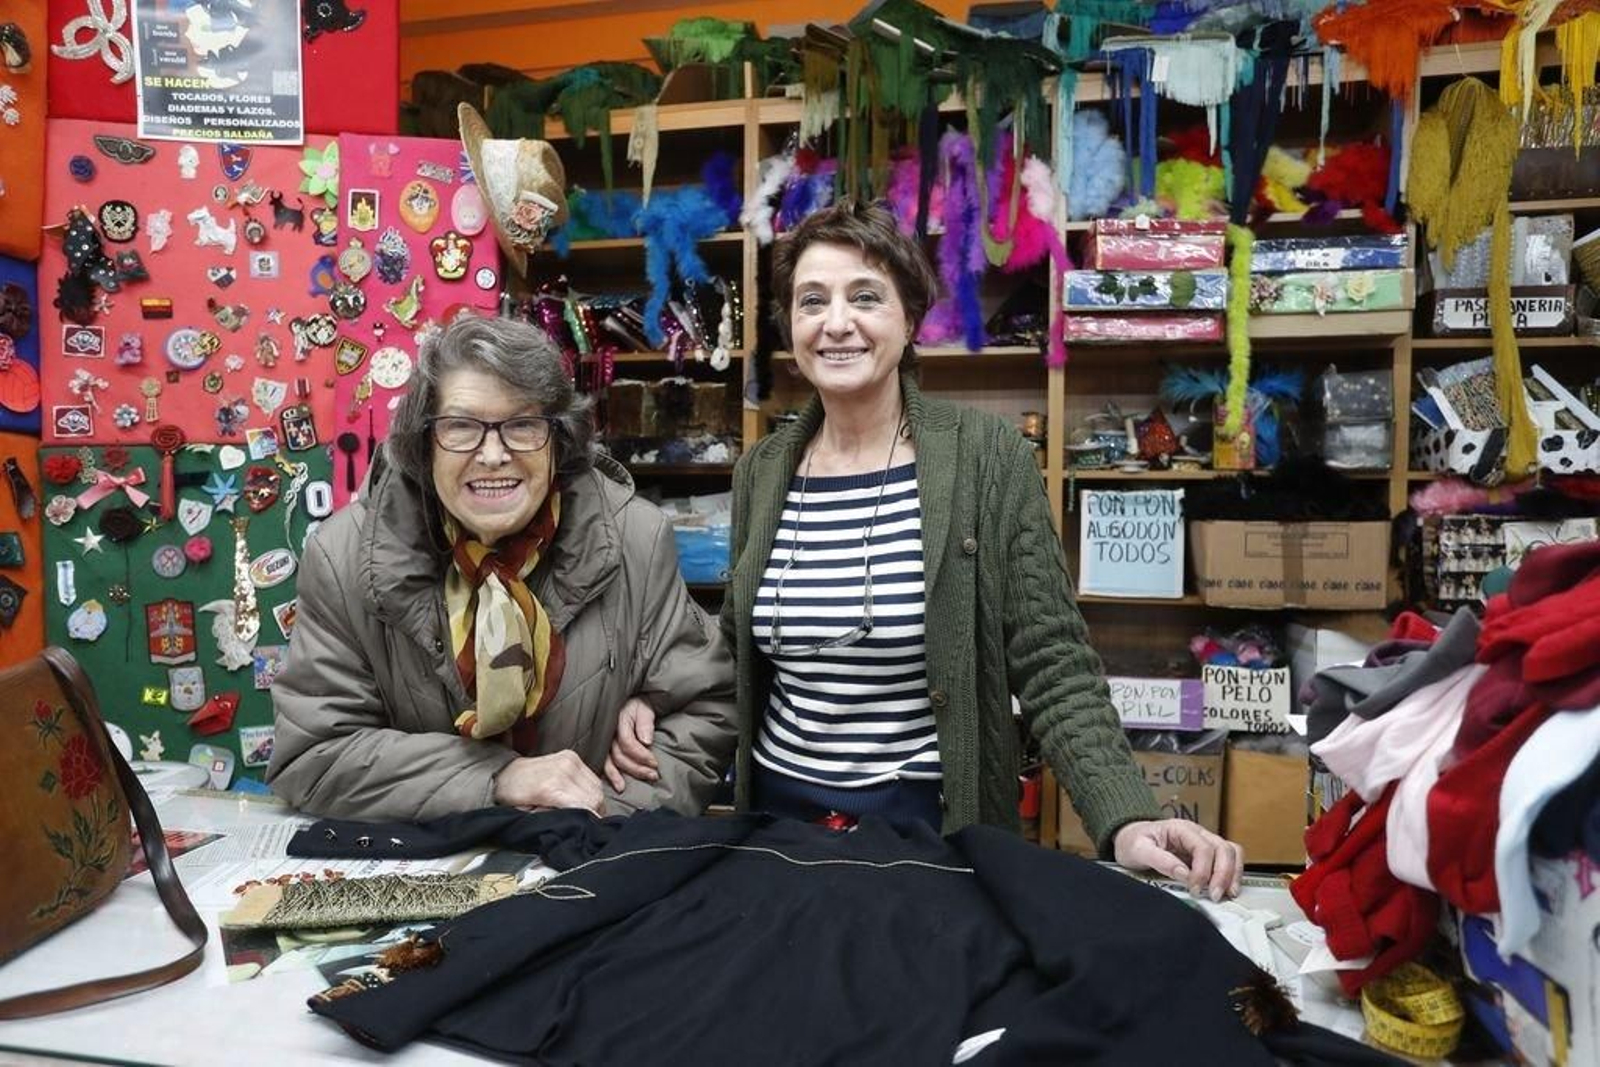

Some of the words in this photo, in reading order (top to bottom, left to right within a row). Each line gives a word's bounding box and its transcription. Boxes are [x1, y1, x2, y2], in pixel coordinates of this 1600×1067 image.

[144, 76, 162, 87] SE
[164, 78, 210, 89] HACEN
[171, 92, 227, 103] TOCADOS,
[229, 95, 271, 104] FLORES
[167, 104, 225, 115] DIADEMAS
[226, 106, 235, 114] Y
[142, 114, 193, 126] DISEÑOS
[203, 117, 300, 129] PERSONALIZADOS
[172, 128, 221, 138] PRECIOS
[222, 130, 274, 140] SALDAÑA
[1087, 493, 1125, 516] PON
[1094, 541, 1170, 564] TODOS
[1204, 666, 1285, 686] PON-PON
[1222, 685, 1272, 703] PELO
[1202, 706, 1273, 723] COLORES
